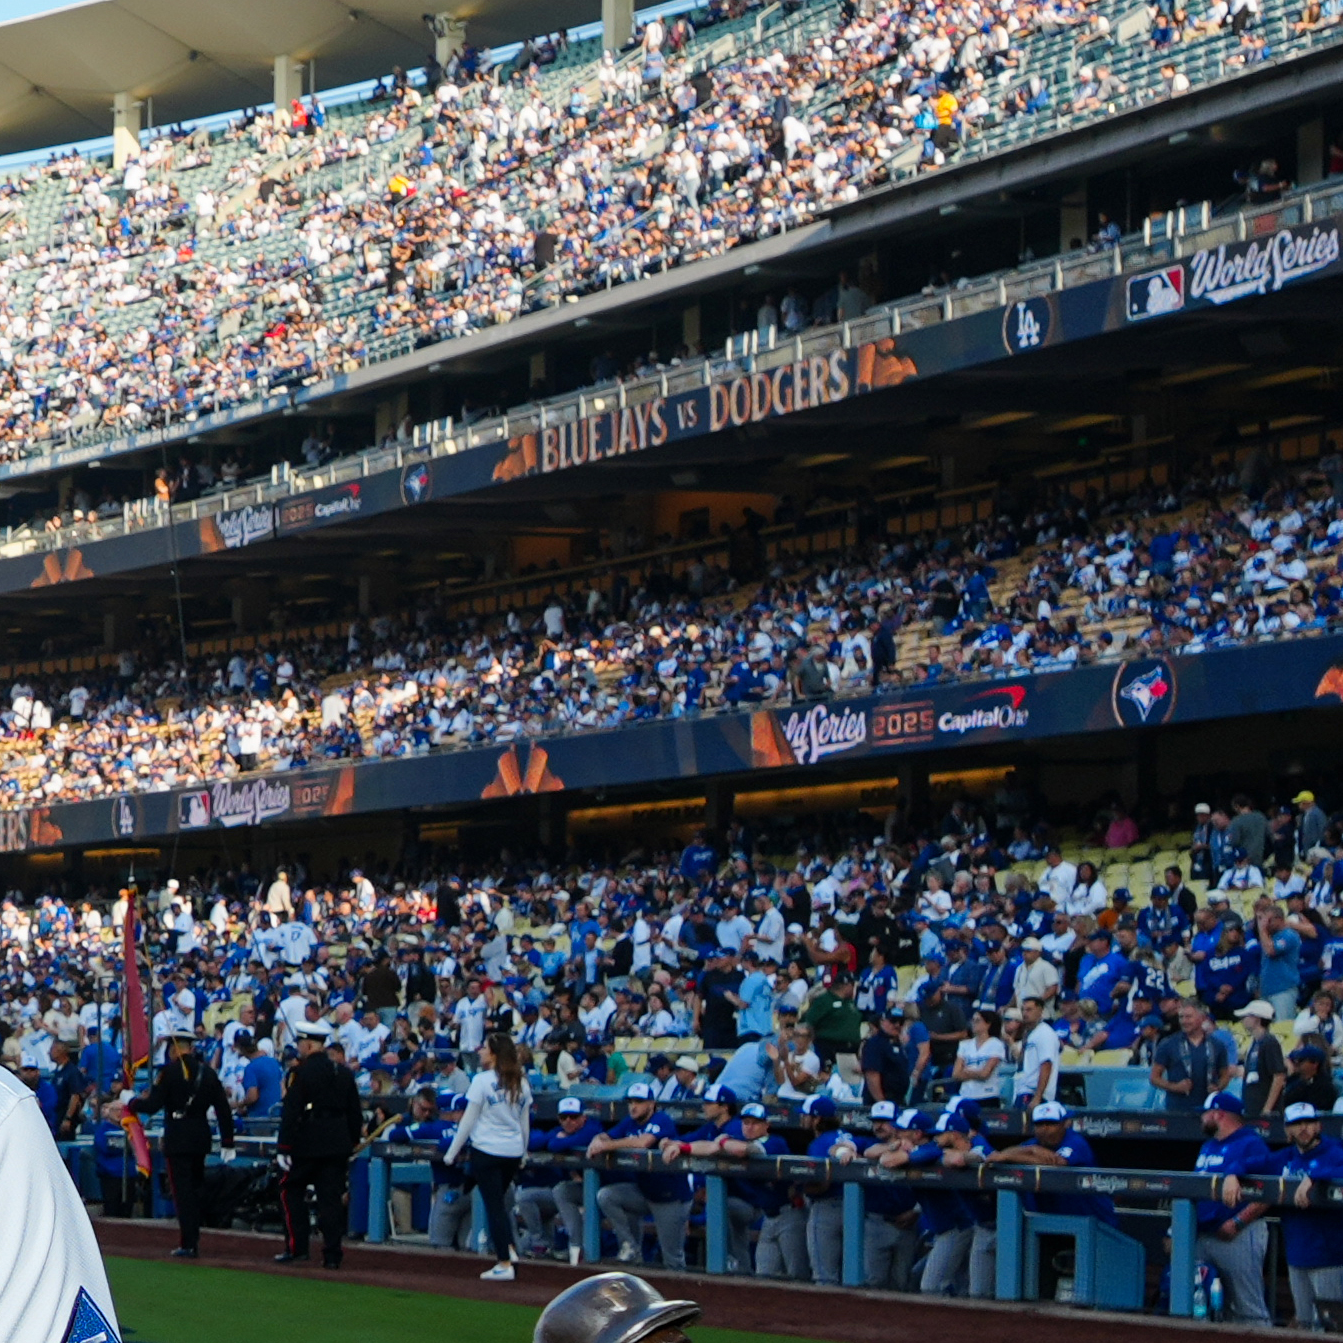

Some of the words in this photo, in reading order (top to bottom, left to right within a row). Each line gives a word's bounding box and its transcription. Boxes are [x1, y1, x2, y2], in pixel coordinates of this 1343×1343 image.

[1016, 302, 1041, 348] LA
[542, 415, 603, 474] BLUE
[605, 396, 668, 457] JAYS
[710, 348, 850, 432] DODGERS
[872, 709, 935, 736] 2025
[1146, 966, 1164, 990] 22
